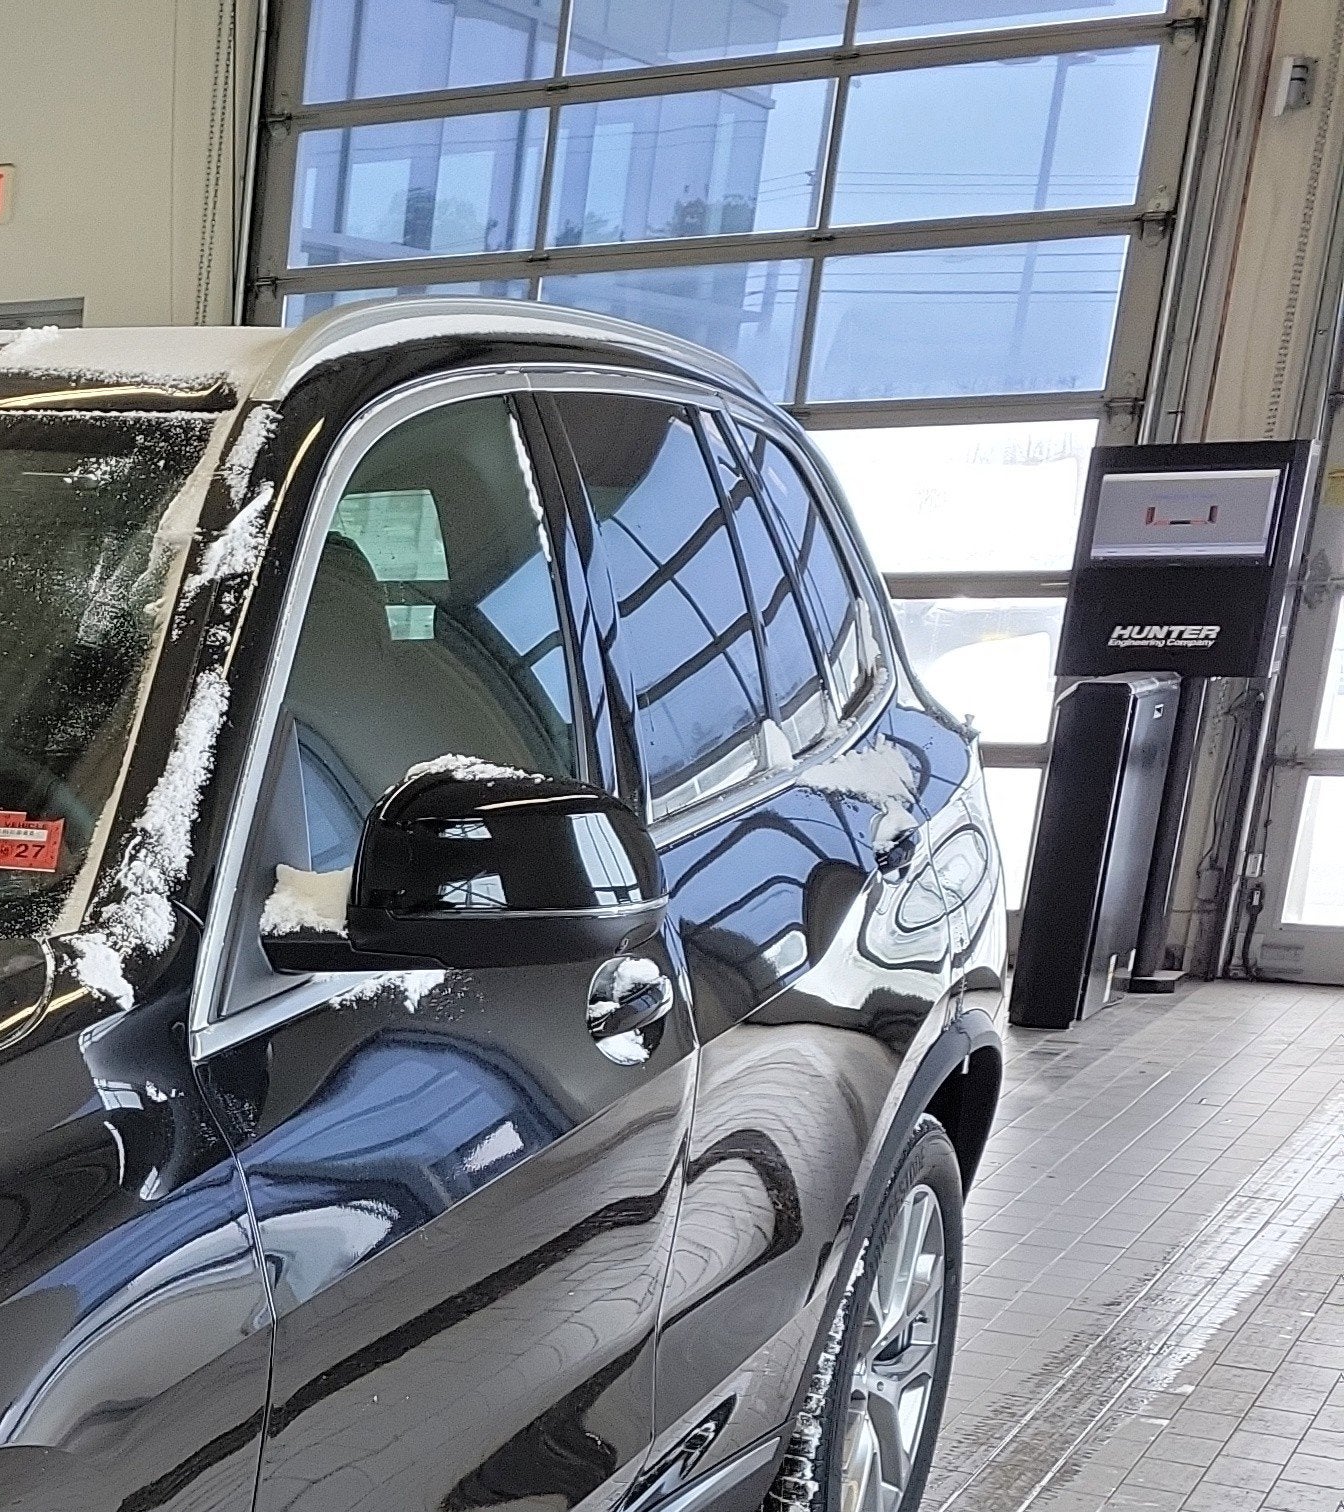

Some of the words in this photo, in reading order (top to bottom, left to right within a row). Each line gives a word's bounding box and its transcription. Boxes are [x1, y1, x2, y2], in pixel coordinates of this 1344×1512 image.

[1111, 625, 1221, 639] HUNTER
[1107, 639, 1165, 648] Engineering
[1166, 639, 1216, 648] Company
[14, 843, 46, 859] 27
